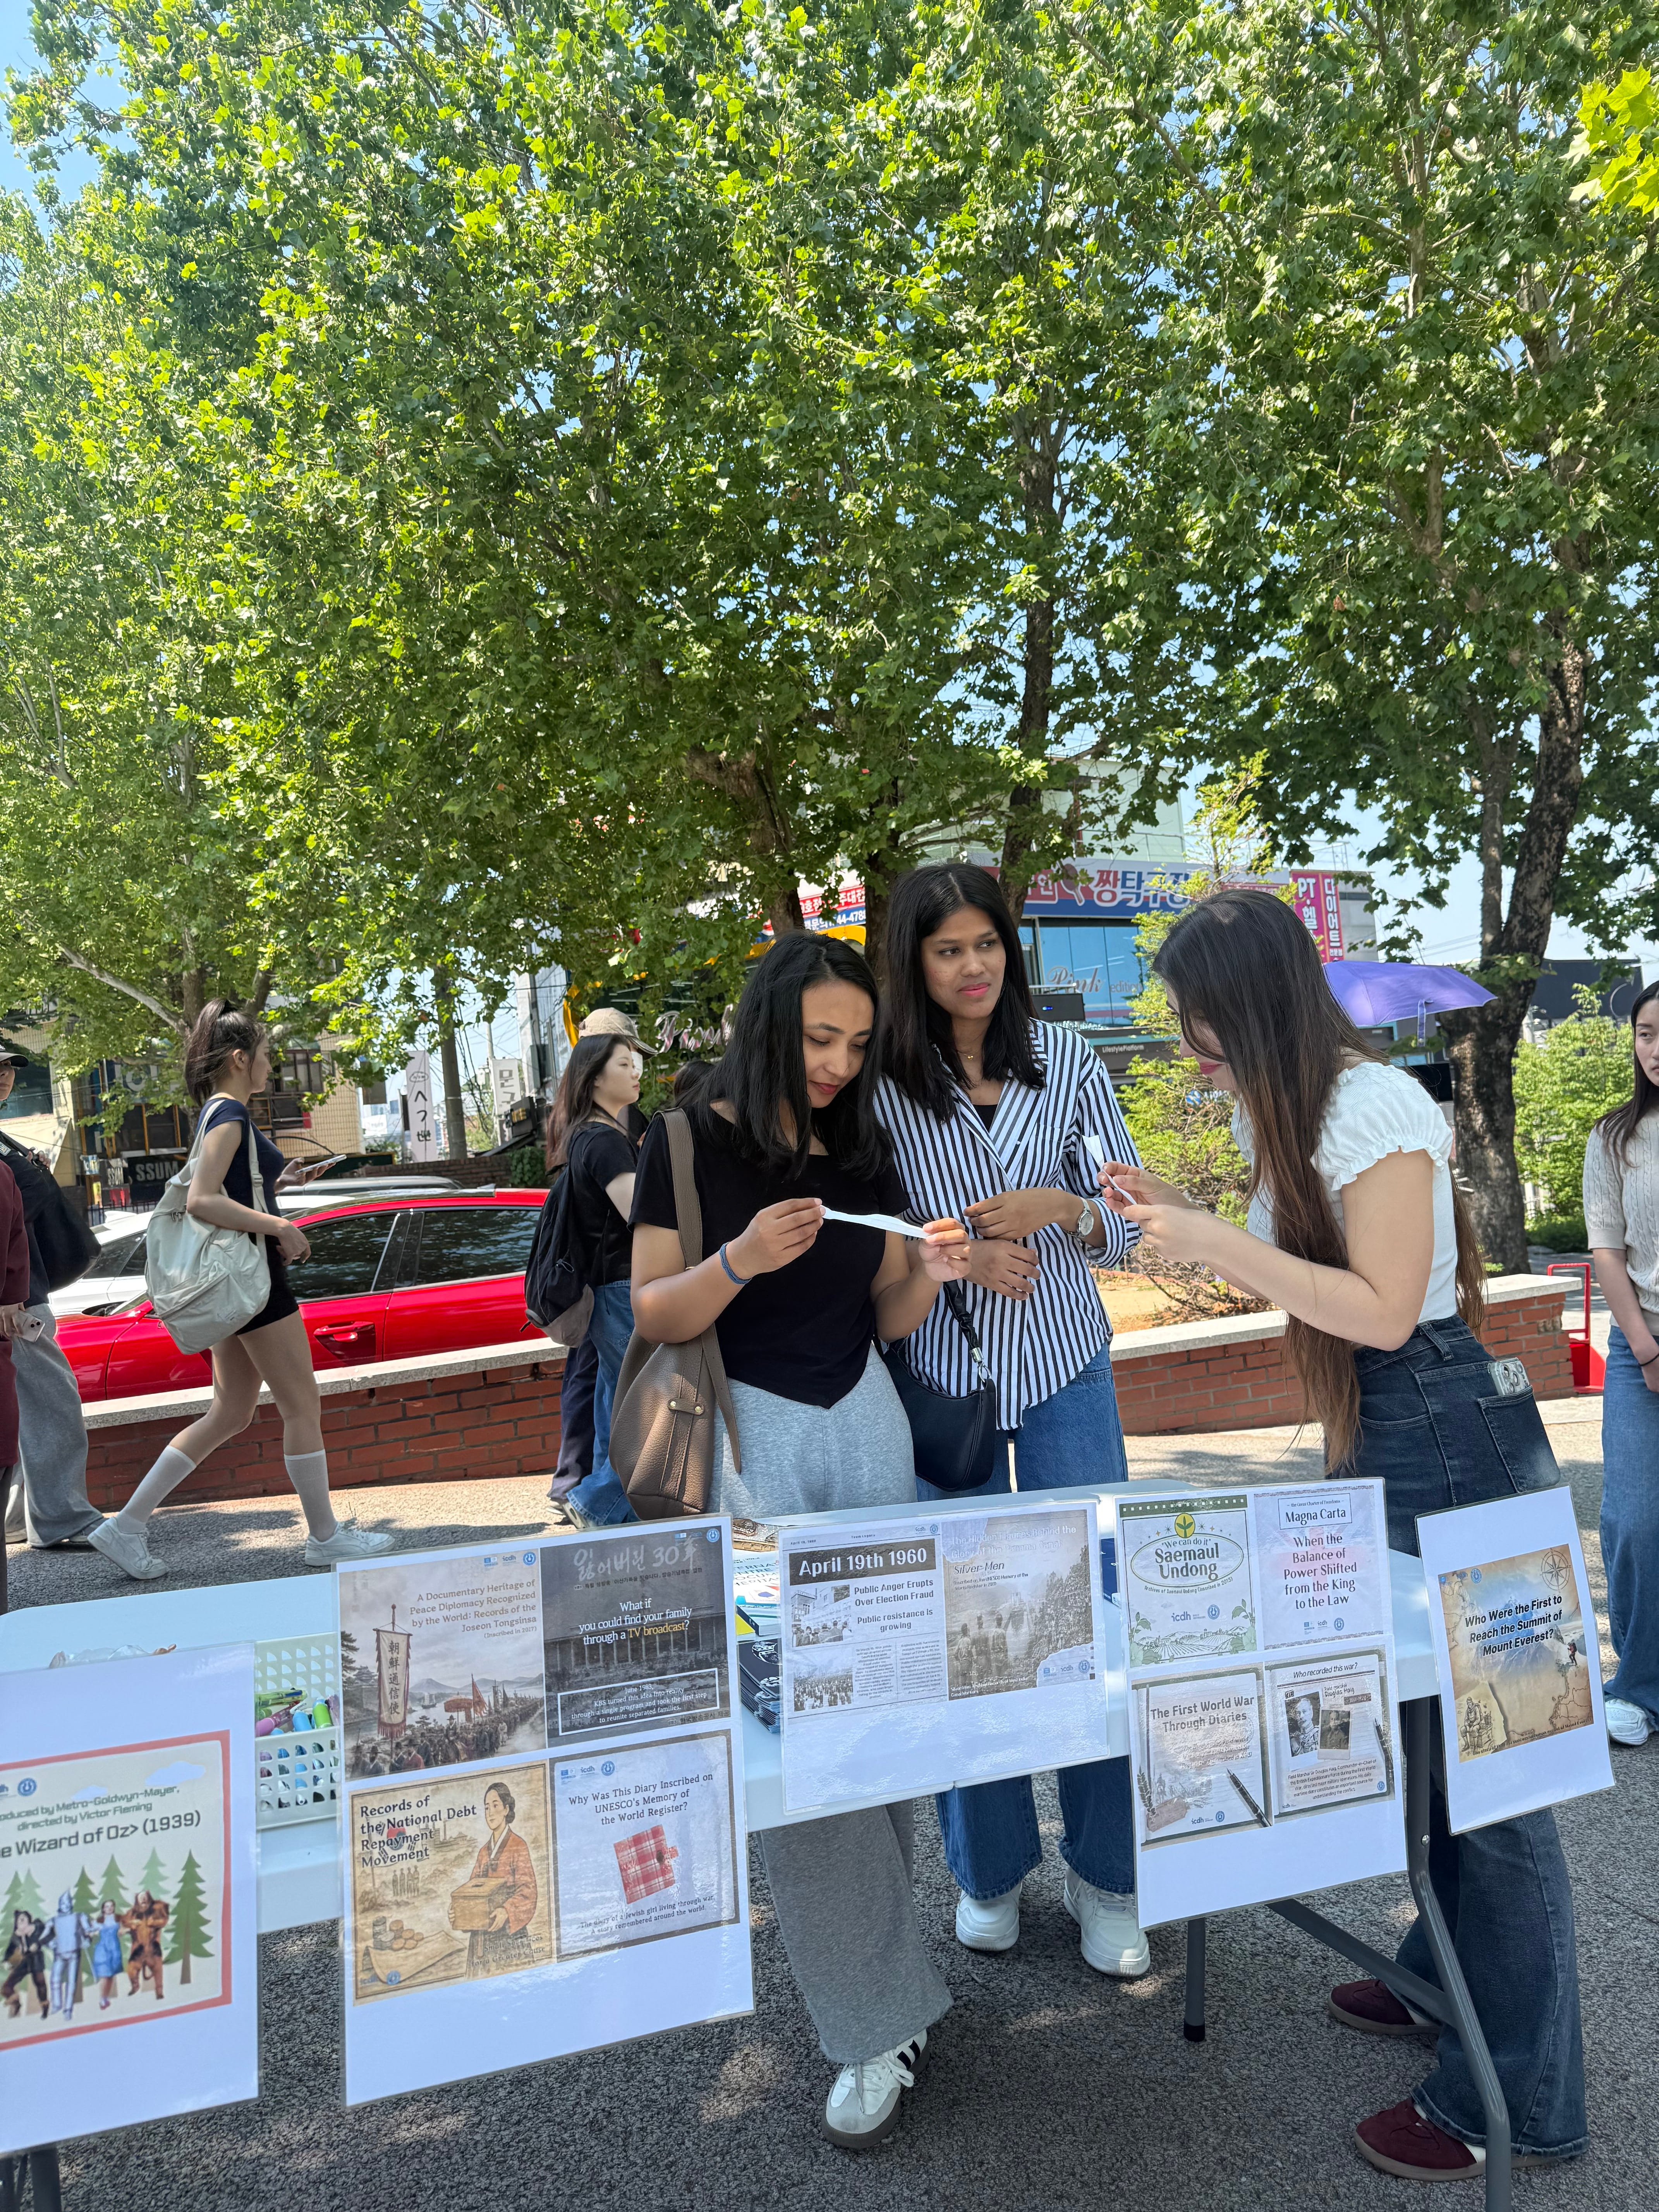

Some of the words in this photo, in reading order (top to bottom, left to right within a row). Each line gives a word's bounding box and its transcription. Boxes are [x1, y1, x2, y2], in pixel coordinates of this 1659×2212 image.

[1048, 966, 1103, 993] Pink
[1110, 980, 1143, 993] edition
[108, 1167, 124, 1185] SSUM
[136, 1161, 179, 1182] SSUM
[1286, 1511, 1317, 1525] Magna
[1320, 1508, 1345, 1519] Carta
[1162, 1540, 1177, 1548] "We
[1293, 1535, 1323, 1547] When
[1326, 1534, 1342, 1544] the
[799, 1557, 841, 1577] April
[847, 1551, 883, 1570] 19th
[888, 1548, 927, 1565] 1960
[1155, 1543, 1219, 1564] Saemaul
[1293, 1551, 1333, 1563] Balance
[1336, 1548, 1346, 1558] of
[1159, 1563, 1219, 1580] Undong
[1284, 1568, 1318, 1580] Power
[1321, 1562, 1357, 1575] Shifted
[426, 1587, 485, 1601] Documentary
[487, 1582, 524, 1593] Heritage
[526, 1579, 536, 1587] of
[854, 1584, 879, 1594] Public
[881, 1582, 905, 1592] Anger
[907, 1579, 933, 1589] Erupts
[1285, 1584, 1310, 1595] from
[1313, 1581, 1329, 1591] the
[1332, 1579, 1356, 1592] King
[410, 1605, 436, 1614] Peace
[439, 1599, 484, 1611] Diplomacy
[487, 1591, 536, 1605] Recognized
[620, 1601, 643, 1612] What
[644, 1599, 651, 1608] if
[855, 1598, 874, 1607] Over
[876, 1594, 908, 1604] Election
[910, 1590, 934, 1599] Fraud
[1296, 1599, 1305, 1609] to
[1308, 1597, 1324, 1607] the
[1328, 1595, 1349, 1606] Law
[412, 1619, 423, 1628] by
[426, 1616, 440, 1625] the
[442, 1613, 471, 1623] World:
[474, 1607, 508, 1618] Records
[511, 1605, 520, 1613] of
[522, 1603, 536, 1611] the
[579, 1623, 596, 1634] you
[598, 1616, 622, 1629] could
[624, 1614, 641, 1625] find
[644, 1612, 663, 1625] your
[666, 1607, 692, 1620] family
[857, 1615, 881, 1625] Public
[883, 1610, 924, 1620] resistance
[1171, 1611, 1191, 1621] icdh
[1465, 1614, 1486, 1627] Who
[1489, 1608, 1513, 1621] Were
[1515, 1604, 1530, 1614] the
[1531, 1598, 1552, 1610] First
[1554, 1595, 1562, 1605] to
[462, 1622, 491, 1632] Joseon
[494, 1616, 536, 1628] Tongsinsa
[484, 1629, 514, 1638] (Inscribed
[583, 1632, 618, 1645] through
[628, 1627, 640, 1638] TV
[643, 1620, 690, 1636] broadcast?
[880, 1622, 911, 1633] growing
[1470, 1630, 1498, 1643] Reach
[1500, 1624, 1515, 1635] the
[1517, 1614, 1551, 1630] Summit
[1554, 1610, 1562, 1621] of
[1482, 1642, 1512, 1657] Mount
[1514, 1629, 1554, 1649] Everest?
[388, 1640, 400, 1715] 朝鮮通信使
[1307, 1667, 1332, 1676] recorded
[572, 1710, 594, 1719] through
[601, 1706, 618, 1716] single
[620, 1702, 643, 1712] program
[608, 1697, 626, 1705] turned
[1151, 1708, 1169, 1720] The
[1173, 1704, 1197, 1716] First
[1200, 1697, 1230, 1712] World
[1234, 1696, 1254, 1706] War
[629, 1709, 656, 1719] separated
[1163, 1717, 1205, 1733] Through
[1209, 1712, 1247, 1725] Diaries
[41, 1807, 55, 1816] by
[56, 1786, 180, 1812] Metro-Goldwyn-Mayer,
[569, 1795, 588, 1806] Why
[591, 1792, 610, 1801] Was
[613, 1788, 631, 1798] This
[634, 1783, 657, 1794] Diary
[660, 1775, 699, 1789] Inscribed
[360, 1799, 412, 1817] Records
[417, 1795, 430, 1808] of
[595, 1798, 639, 1814] UNESCO's
[643, 1792, 677, 1805] Memory
[680, 1790, 690, 1798] of
[17, 1816, 62, 1831] directed
[64, 1814, 77, 1826] by
[79, 1809, 111, 1821] Victor
[114, 1802, 153, 1816] Fleming
[361, 1823, 382, 1834] the
[387, 1810, 441, 1830] National
[447, 1805, 477, 1819] Debt
[601, 1816, 615, 1825] the
[618, 1810, 645, 1822] World
[648, 1802, 688, 1817] Register?
[15, 1832, 78, 1855] Wizard
[84, 1827, 103, 1843] of
[107, 1824, 139, 1839] Oz>
[143, 1810, 201, 1835] (1939)
[361, 1829, 434, 1851] Repayment
[361, 1847, 429, 1868] Movement
[626, 1910, 644, 1919] Jewish
[647, 1907, 657, 1915] girl
[659, 1903, 676, 1911] living
[678, 1898, 701, 1907] through
[615, 1917, 652, 1929] remembered
[654, 1911, 675, 1921] around
